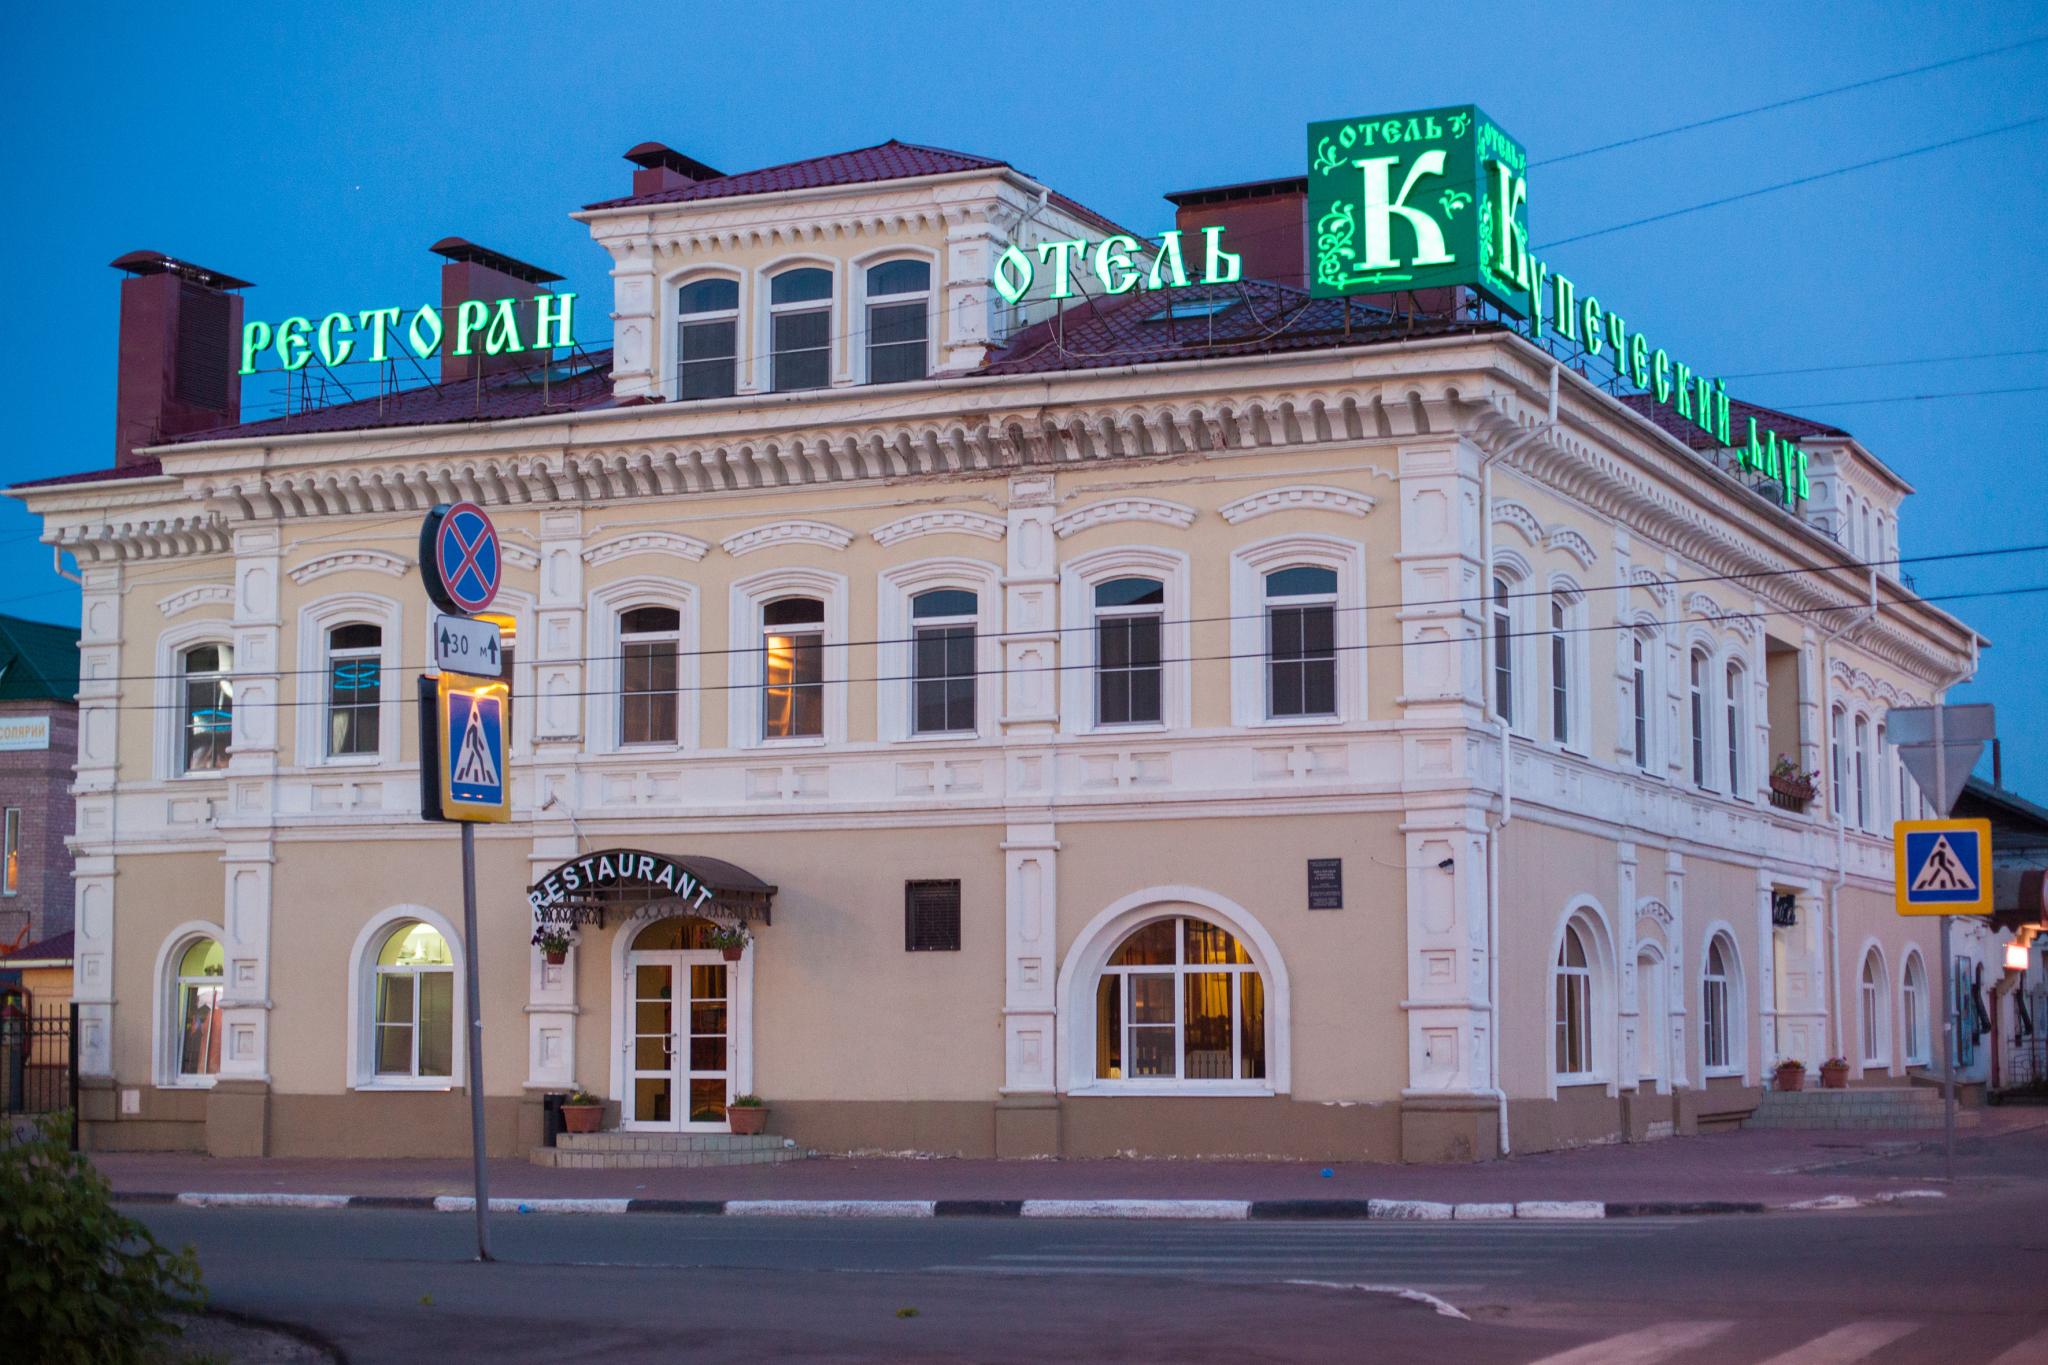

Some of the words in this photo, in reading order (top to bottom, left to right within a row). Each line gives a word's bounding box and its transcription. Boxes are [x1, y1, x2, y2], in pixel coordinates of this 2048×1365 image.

[1339, 116, 1443, 148] ОТЕЛЬ
[993, 226, 1242, 305] ОТЕЛЬ
[238, 292, 577, 376] РЕСТОРАН
[451, 633, 469, 656] 30
[528, 852, 713, 916] RESTAURANT
